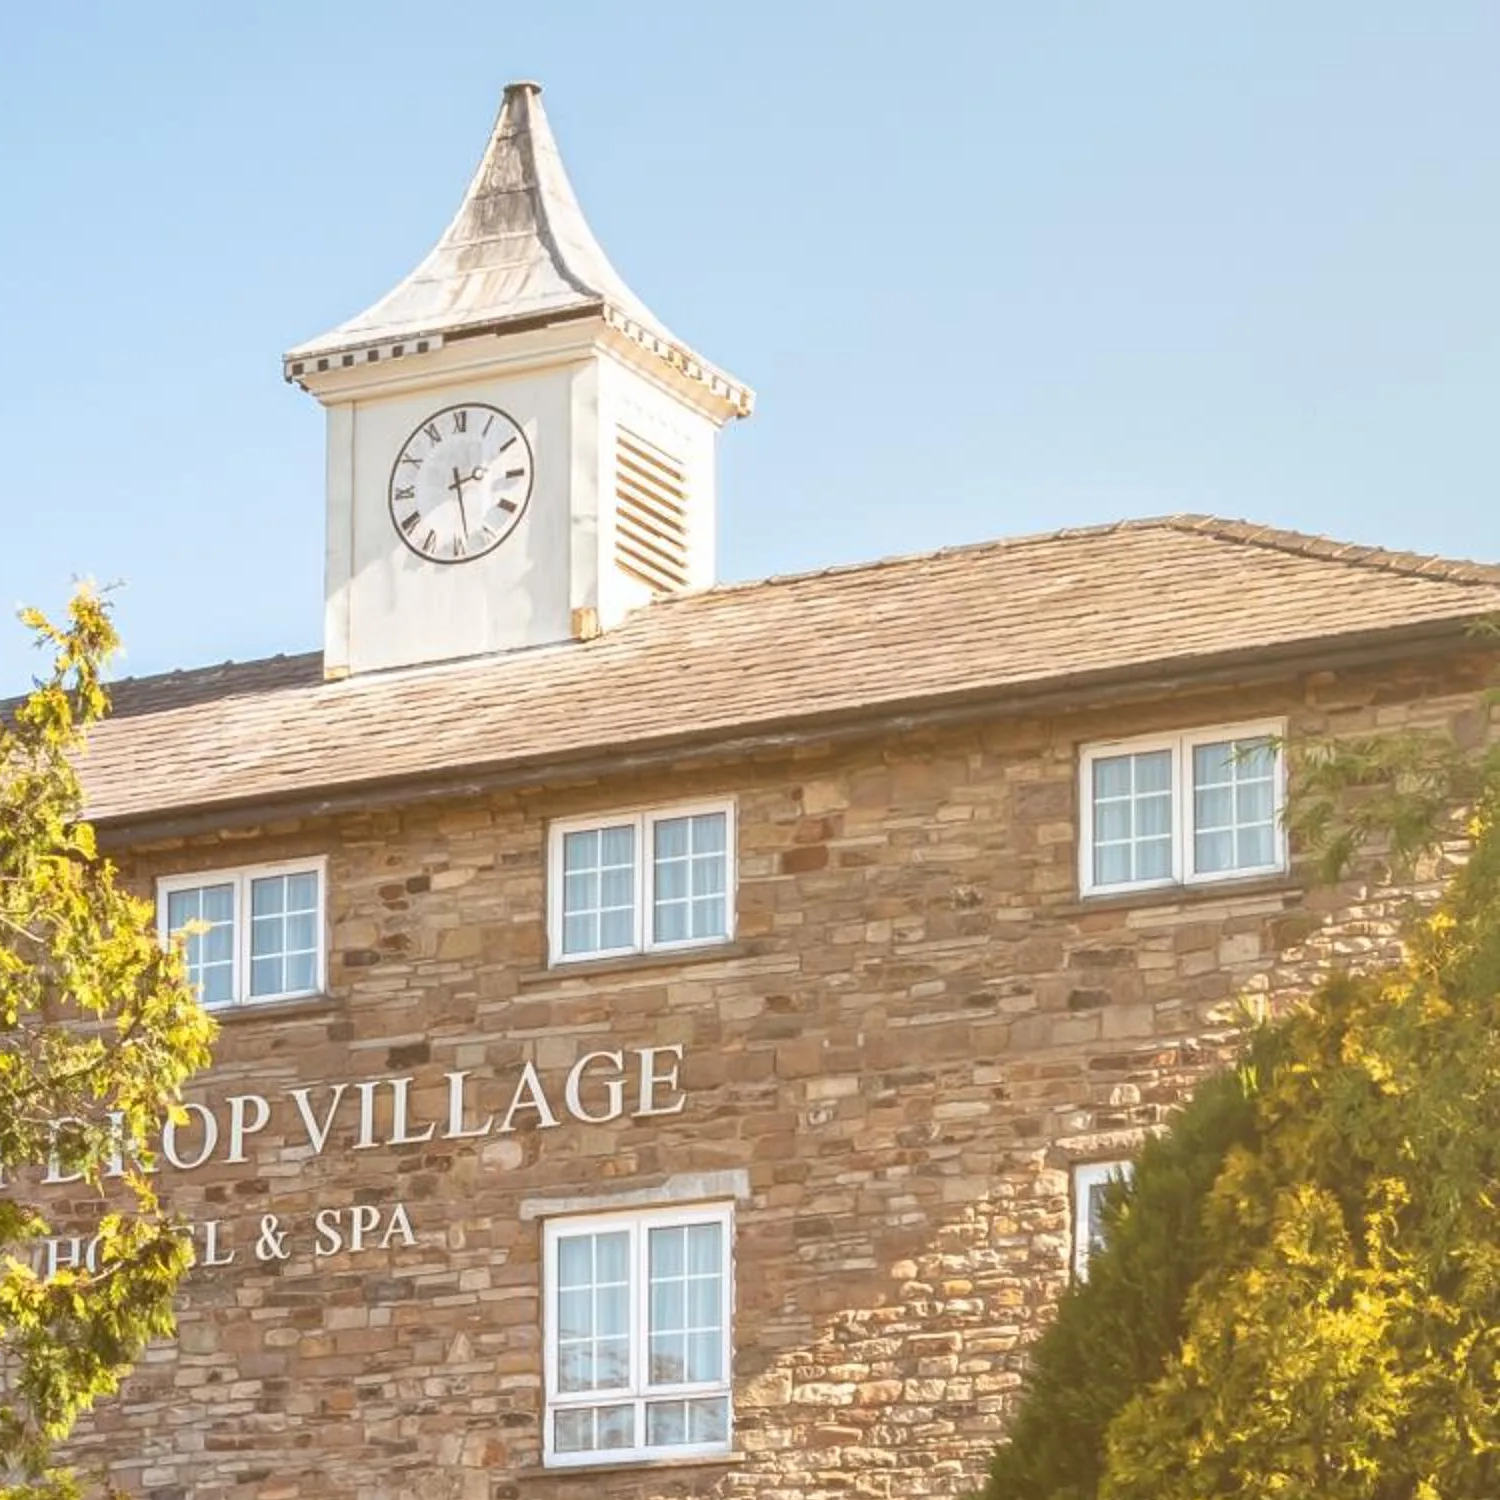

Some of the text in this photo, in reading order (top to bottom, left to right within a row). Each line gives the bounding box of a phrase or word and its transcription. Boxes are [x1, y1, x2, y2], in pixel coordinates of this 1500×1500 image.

[289, 1043, 687, 1155] VILLAGE
[255, 1213, 290, 1261] &
[315, 1201, 419, 1257] SPA
